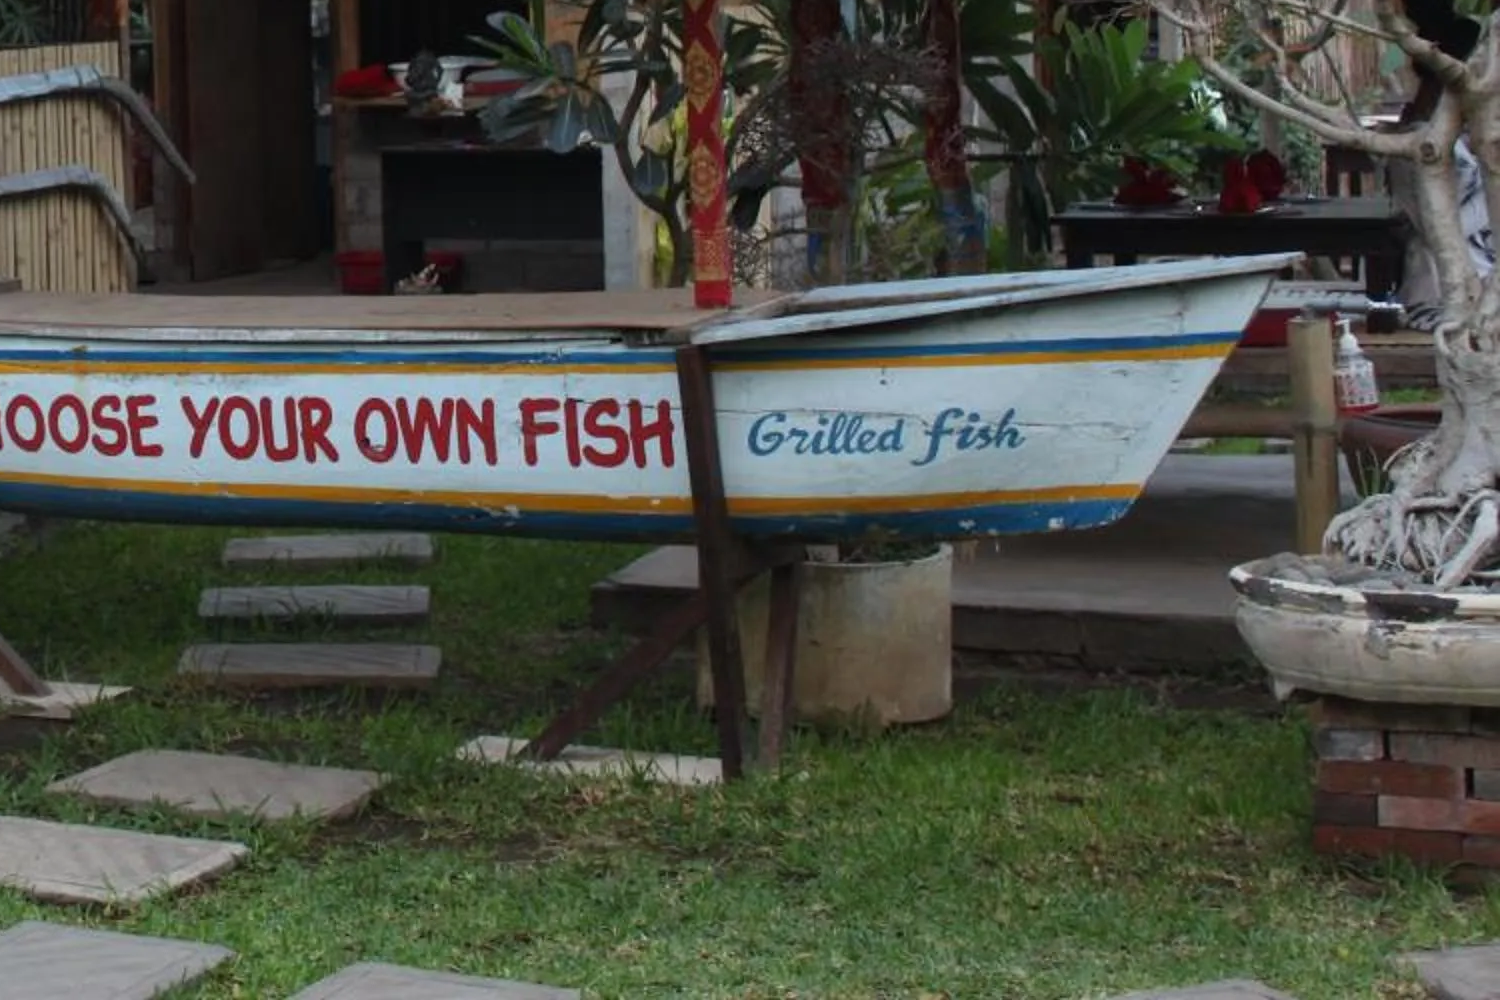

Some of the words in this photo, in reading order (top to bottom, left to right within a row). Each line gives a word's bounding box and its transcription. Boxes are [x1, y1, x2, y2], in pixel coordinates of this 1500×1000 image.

[180, 396, 340, 464] YOUR
[354, 397, 498, 467] OWN
[520, 398, 674, 469] FISH
[747, 411, 905, 456] Grilled
[911, 407, 1026, 466] fish
